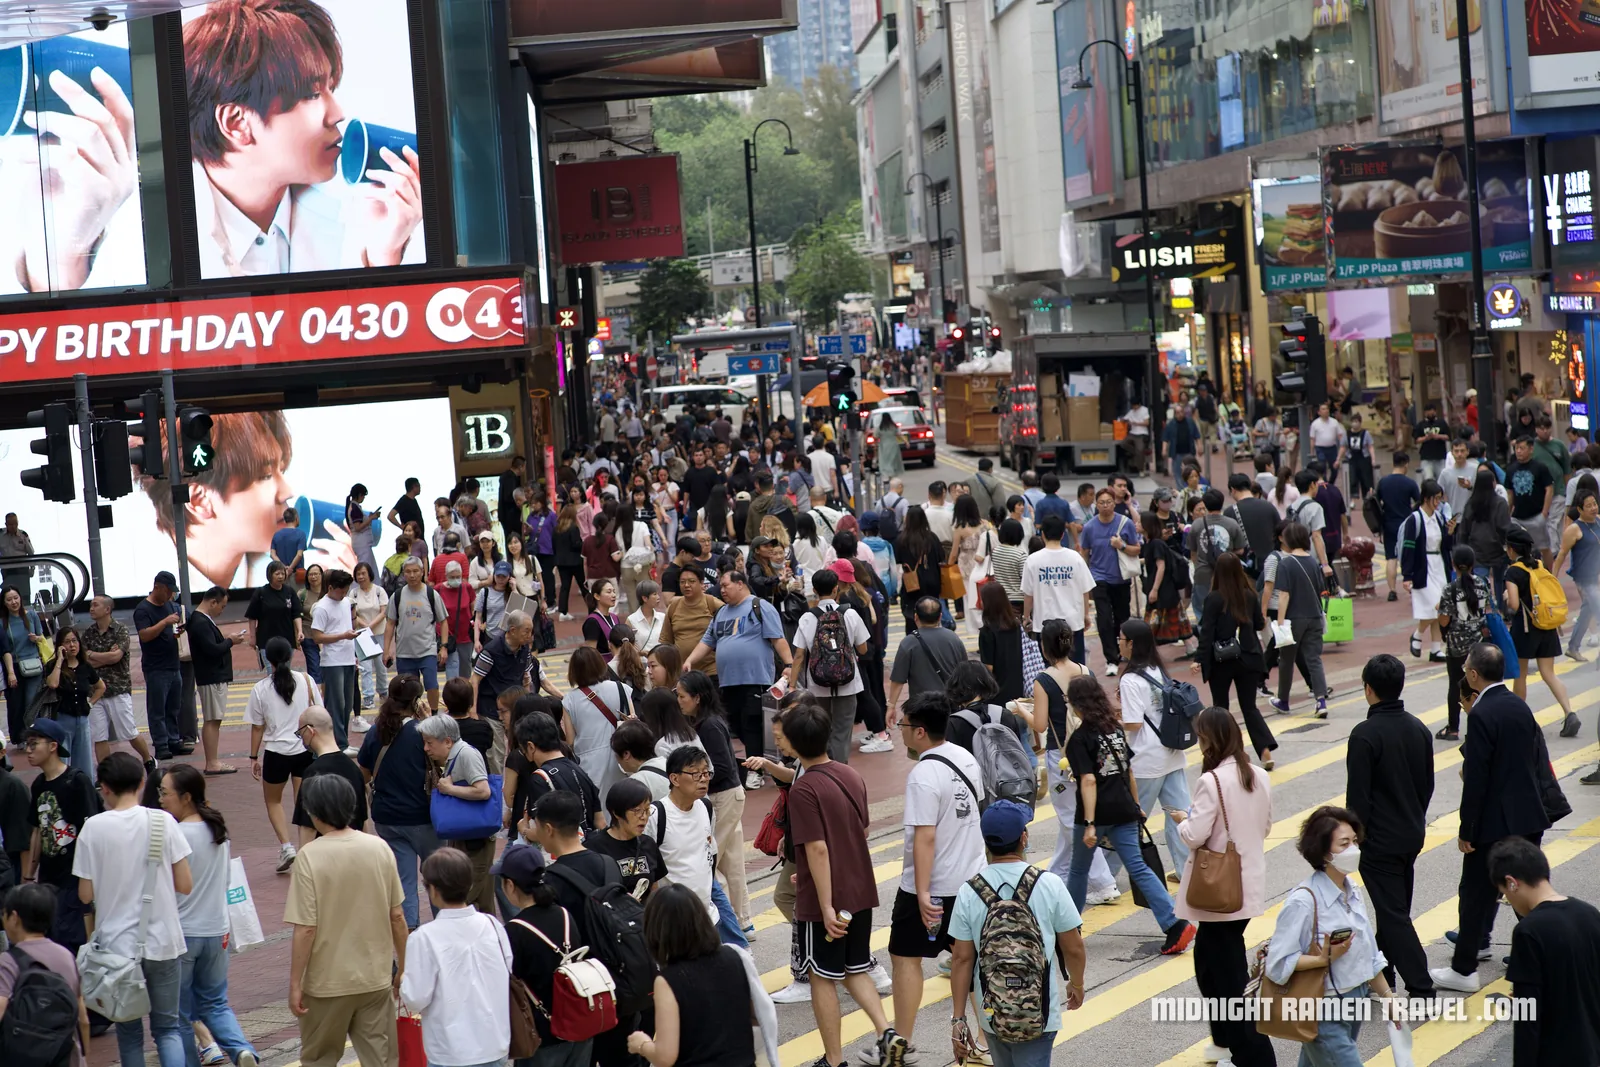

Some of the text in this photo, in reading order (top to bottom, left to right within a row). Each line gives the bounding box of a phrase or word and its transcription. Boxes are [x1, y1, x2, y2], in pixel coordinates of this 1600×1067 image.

[954, 14, 971, 121] FASHION WALK
[1565, 195, 1593, 214] CHANGE
[616, 224, 680, 239] BEVERLEY
[1124, 246, 1193, 268] LUSH
[1194, 244, 1225, 253] FRESH
[1339, 265, 1355, 277] 1/F
[1356, 264, 1370, 275] JP
[1371, 262, 1398, 273] Plaza
[1271, 273, 1287, 286] 1/F
[1289, 272, 1302, 284] JP
[55, 310, 284, 361] BIRTHDAY
[300, 301, 408, 344] 0430
[465, 413, 511, 455] iB
[1038, 572, 1073, 581] phonic
